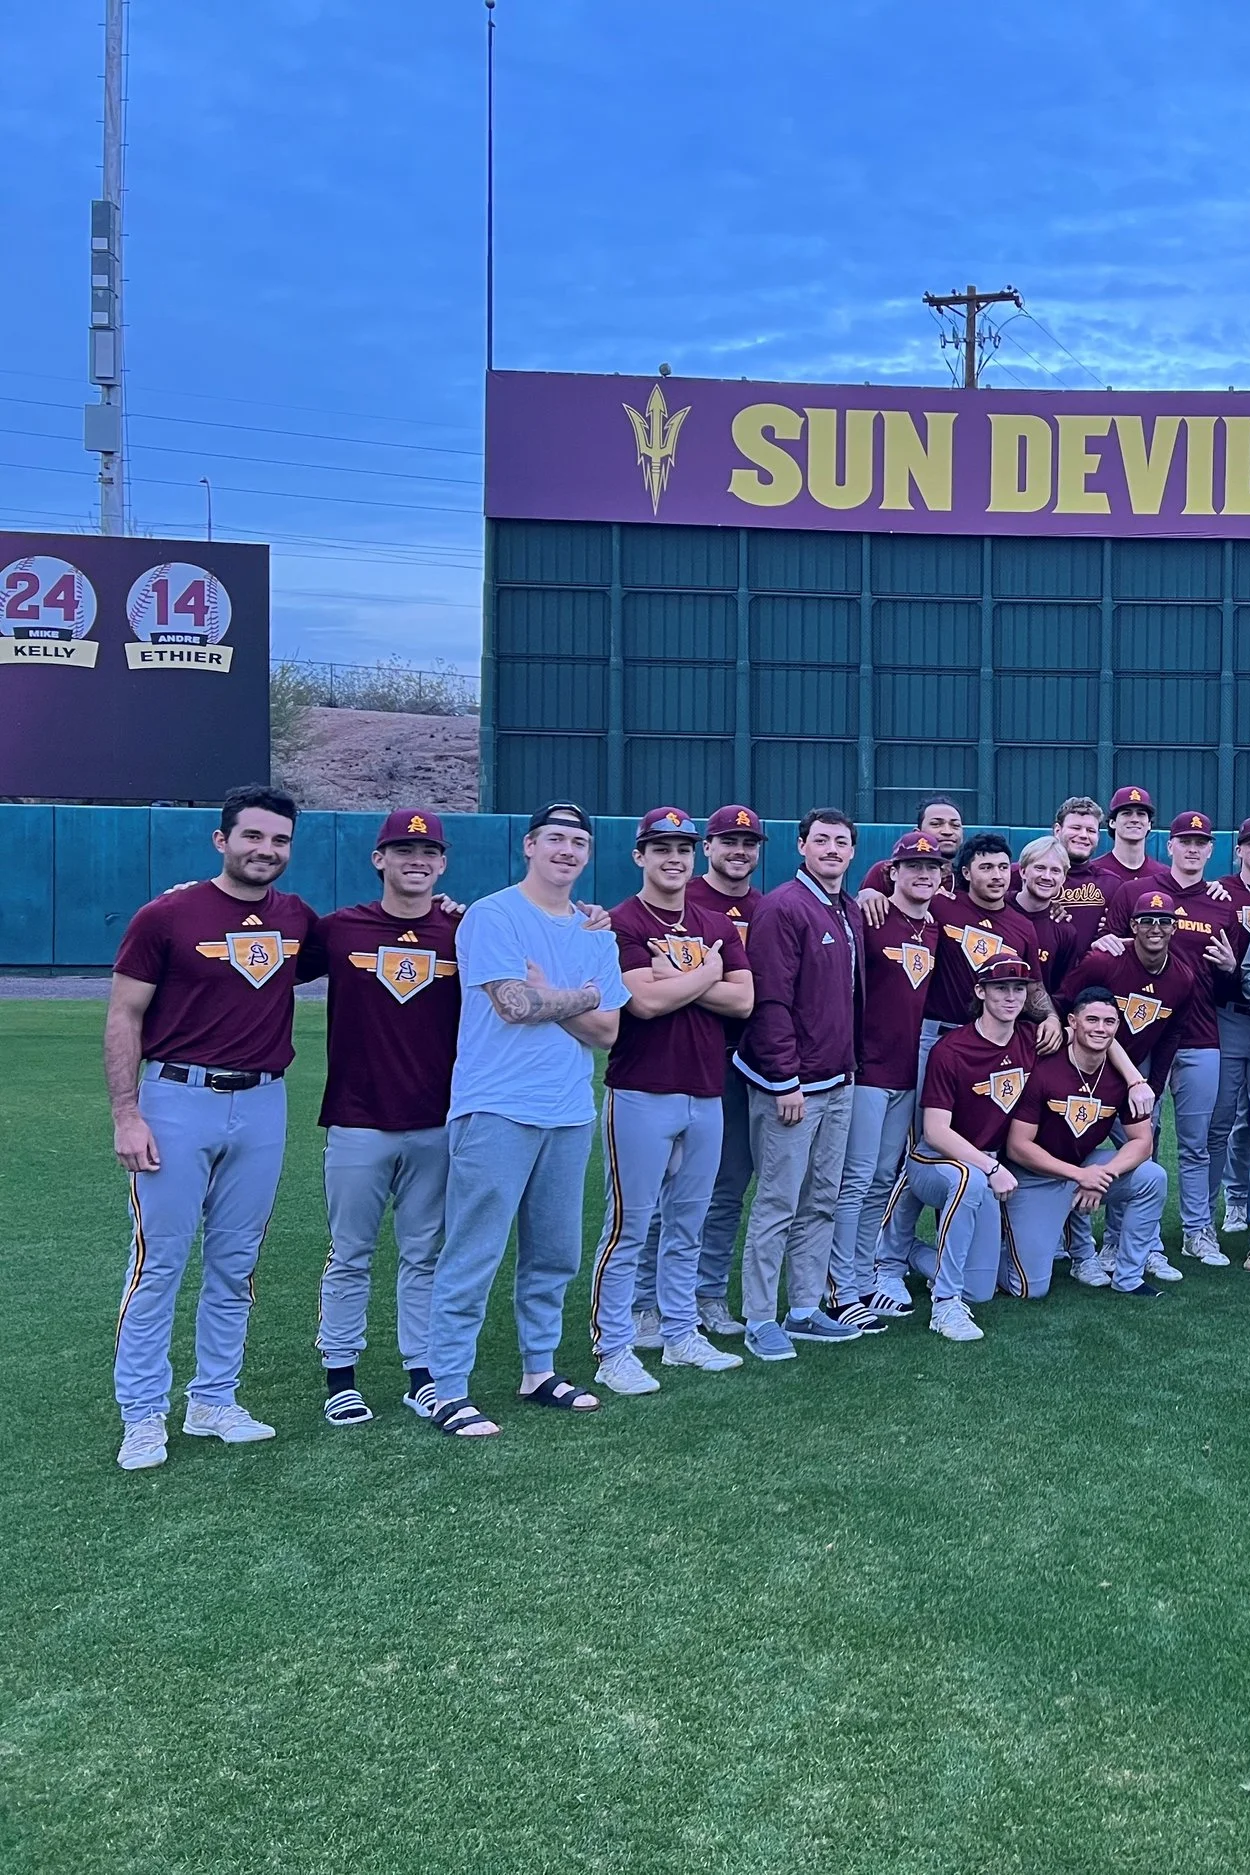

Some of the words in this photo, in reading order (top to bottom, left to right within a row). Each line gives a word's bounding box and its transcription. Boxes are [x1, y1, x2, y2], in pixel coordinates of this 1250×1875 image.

[727, 402, 958, 511] SUN
[5, 572, 80, 622] 24
[151, 578, 210, 627] 14
[29, 629, 60, 639] MIKE
[158, 634, 201, 644] ANDRE
[14, 645, 76, 659] KELLY
[140, 650, 222, 665] ETHIER
